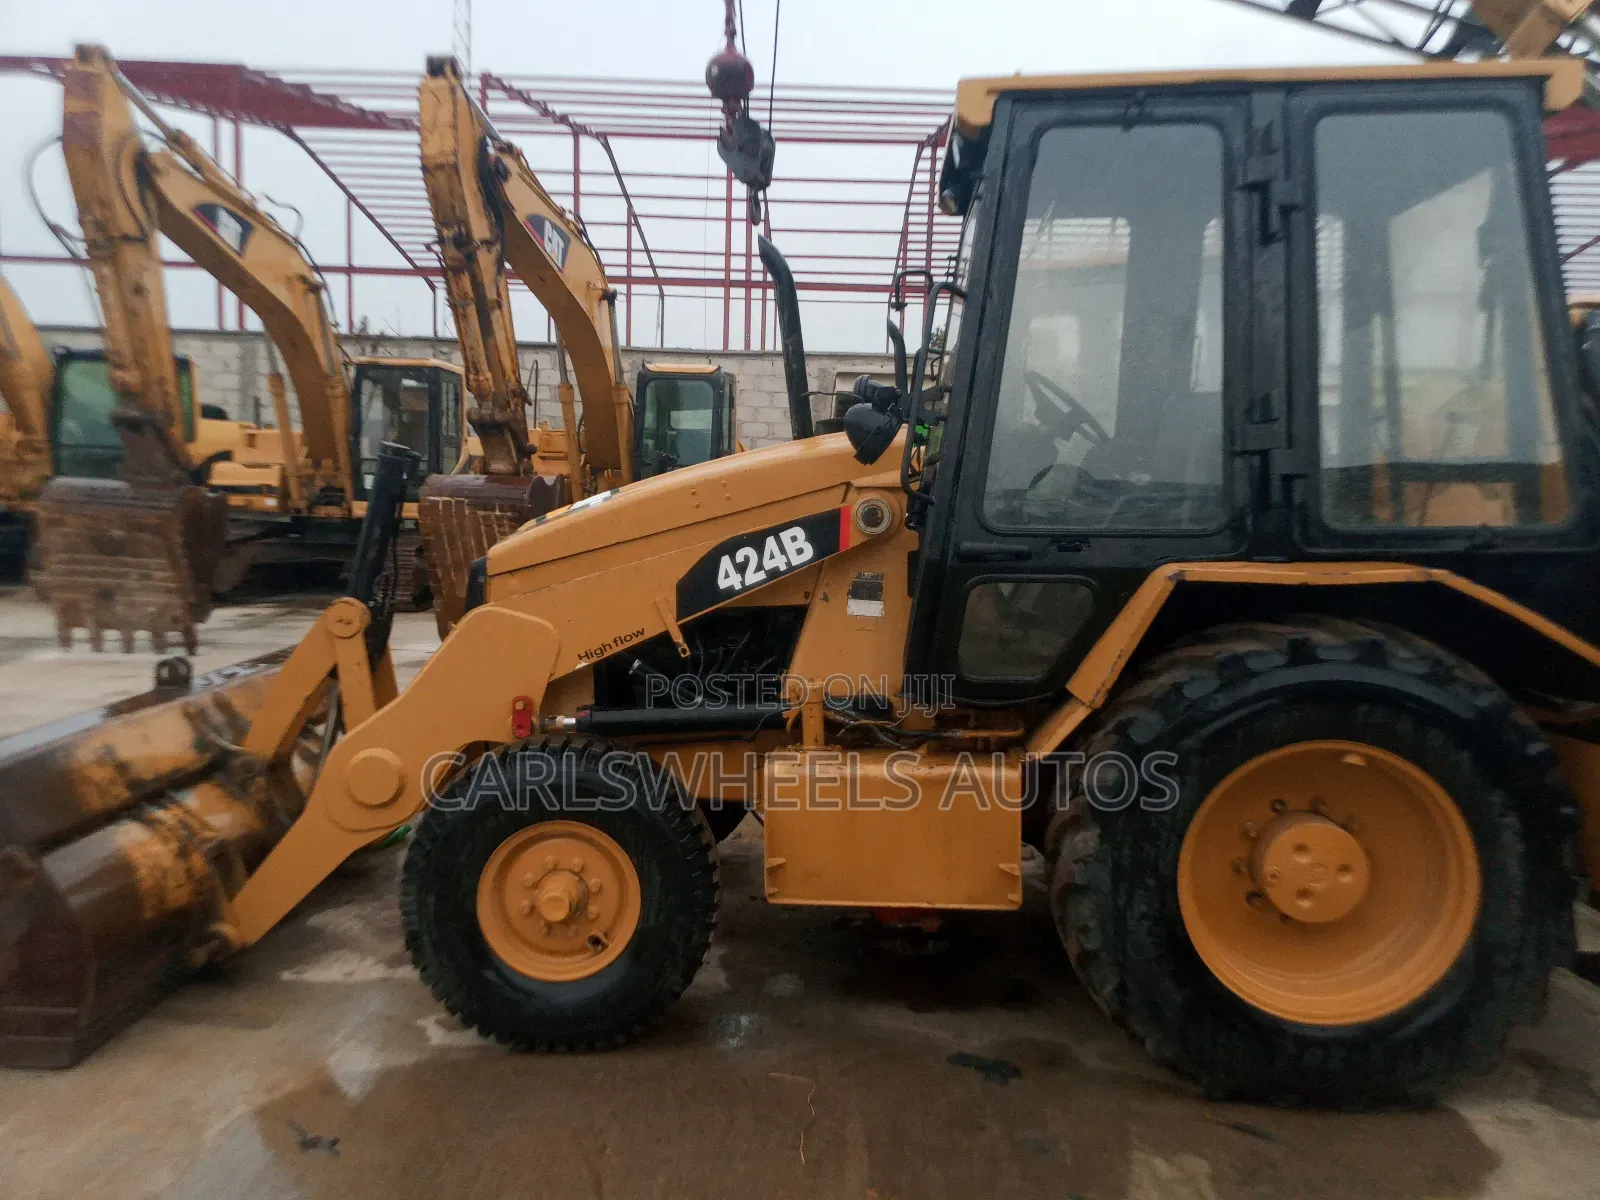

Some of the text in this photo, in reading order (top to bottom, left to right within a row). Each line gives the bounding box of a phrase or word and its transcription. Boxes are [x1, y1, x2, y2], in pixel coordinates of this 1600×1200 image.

[717, 526, 814, 591] 424B
[577, 627, 645, 661] High flow
